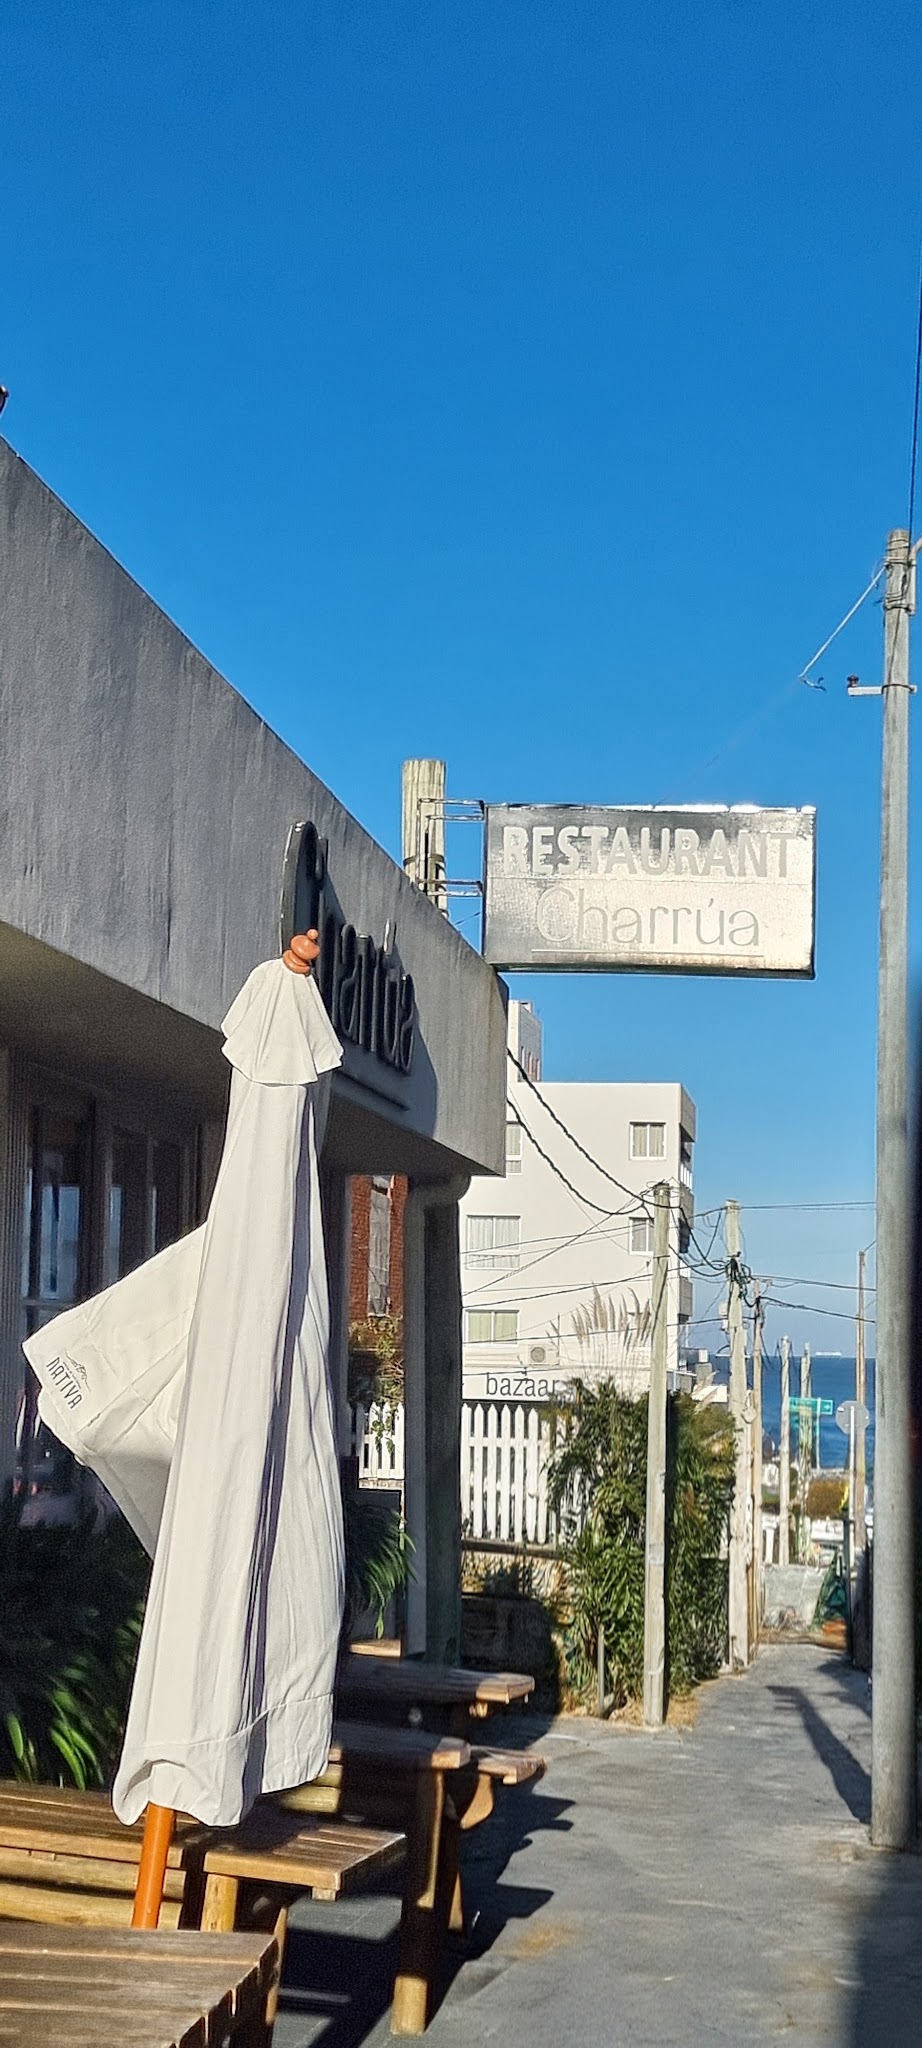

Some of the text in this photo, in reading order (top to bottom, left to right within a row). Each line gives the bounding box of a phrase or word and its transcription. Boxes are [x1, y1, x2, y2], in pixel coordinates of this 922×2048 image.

[502, 824, 796, 879] RESTAURANT
[535, 884, 760, 946] Charrúa
[46, 1356, 83, 1410] NATIVA
[485, 1372, 560, 1398] bazaar
